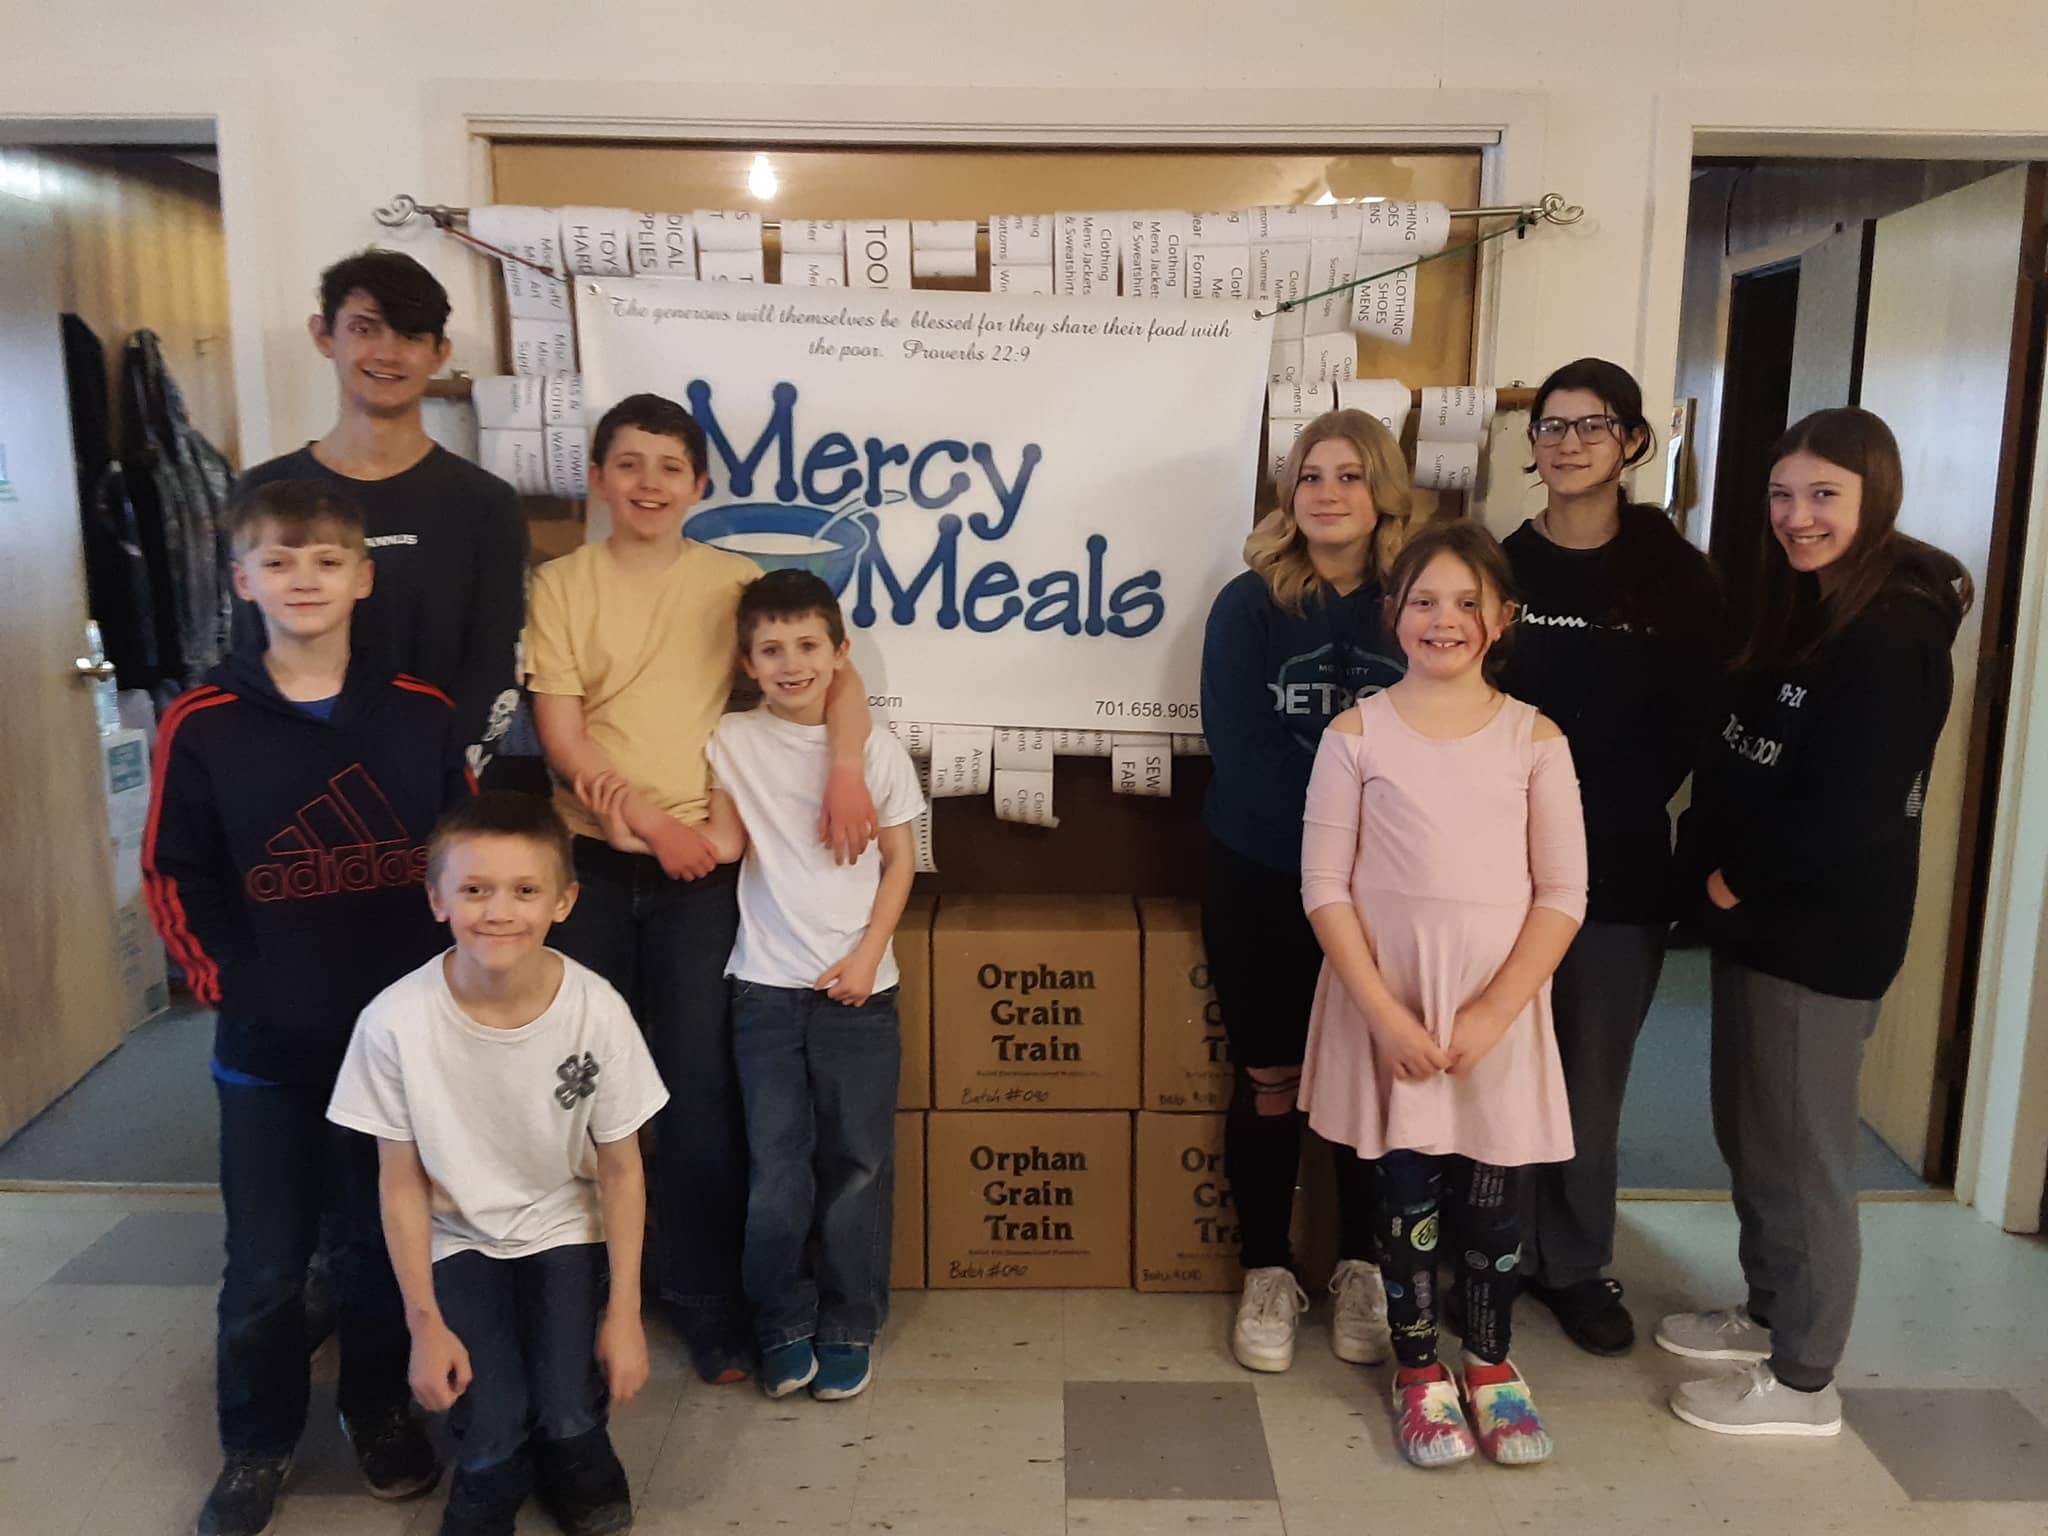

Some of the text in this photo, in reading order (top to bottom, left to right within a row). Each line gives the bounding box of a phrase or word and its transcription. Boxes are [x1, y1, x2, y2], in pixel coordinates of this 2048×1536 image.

[1082, 215, 1094, 250] Mens
[1150, 221, 1162, 255] Mens
[864, 224, 890, 289] TOO
[1098, 227, 1113, 282] Clothing
[1165, 234, 1180, 288] Clothing
[1259, 248, 1270, 292] Summer
[1358, 284, 1372, 323] MENS
[1375, 281, 1390, 325] SHOES
[1391, 270, 1409, 337] CLOTHING
[651, 306, 732, 325] generous
[735, 303, 773, 324] will
[778, 305, 875, 328] themselves
[879, 308, 899, 328] be
[910, 309, 973, 331] blessed
[977, 311, 1003, 337] for
[1008, 312, 1045, 339] they
[1051, 314, 1098, 336] share
[1102, 315, 1143, 337] their
[1147, 318, 1187, 343] food
[1190, 318, 1231, 339] with
[807, 336, 1031, 363] the poor. Proverbs 22:9
[1437, 405, 1448, 427] tops
[686, 379, 1043, 541] Mercy
[851, 513, 1165, 638] Meals
[1095, 701, 1200, 721] 701.658.905
[936, 767, 949, 789] Ties
[953, 756, 967, 783] Belts
[245, 844, 429, 903] adidas
[976, 963, 1096, 996] Orphan
[990, 999, 1084, 1026] Grain
[990, 1034, 1082, 1063] Train
[961, 1087, 1001, 1106] Batch
[969, 1145, 1088, 1177] Orphan
[982, 1180, 1075, 1207] Grain
[983, 1215, 1074, 1242] Train
[949, 1260, 985, 1280] Batch
